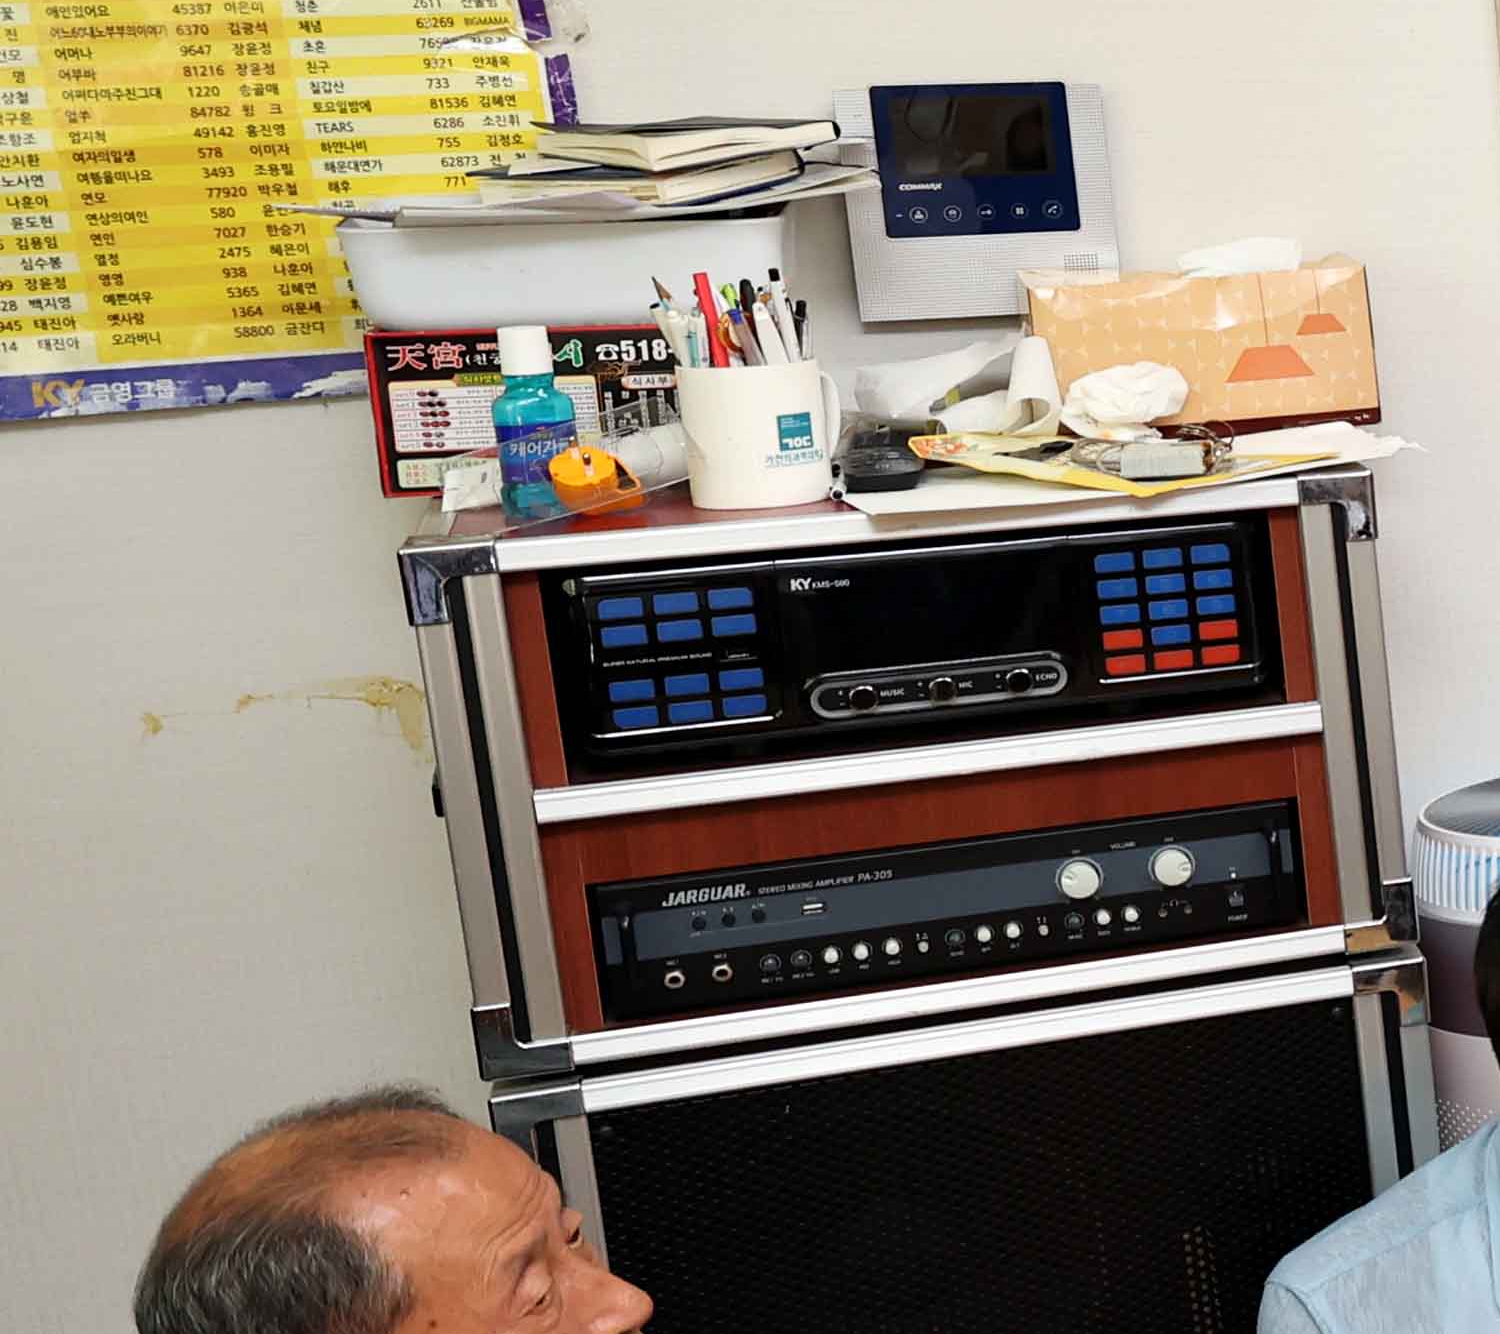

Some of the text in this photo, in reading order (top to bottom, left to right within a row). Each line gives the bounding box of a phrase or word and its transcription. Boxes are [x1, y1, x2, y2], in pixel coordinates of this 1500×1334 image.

[54, 44, 212, 61] 어머나 9647
[425, 77, 450, 90] 733
[312, 100, 372, 114] 토요일밤에
[429, 97, 469, 109] 81536
[316, 117, 465, 133] TEARS 6286
[320, 141, 368, 154] 하얀나비
[437, 136, 461, 149] 755
[198, 147, 223, 160] 578
[444, 176, 467, 187] 771
[899, 182, 943, 191] COMMAX
[226, 286, 259, 299] 5365
[234, 325, 274, 339] 58800
[31, 378, 175, 408] KY 금영그룹
[509, 440, 566, 456] 케어가
[790, 577, 812, 591] KY
[1036, 672, 1058, 681] ECHO
[959, 681, 973, 689] MIC
[880, 688, 905, 697] MUSIC
[661, 869, 894, 907] JARGUAR STEREO MIXING AMPLIFIER PA-305
